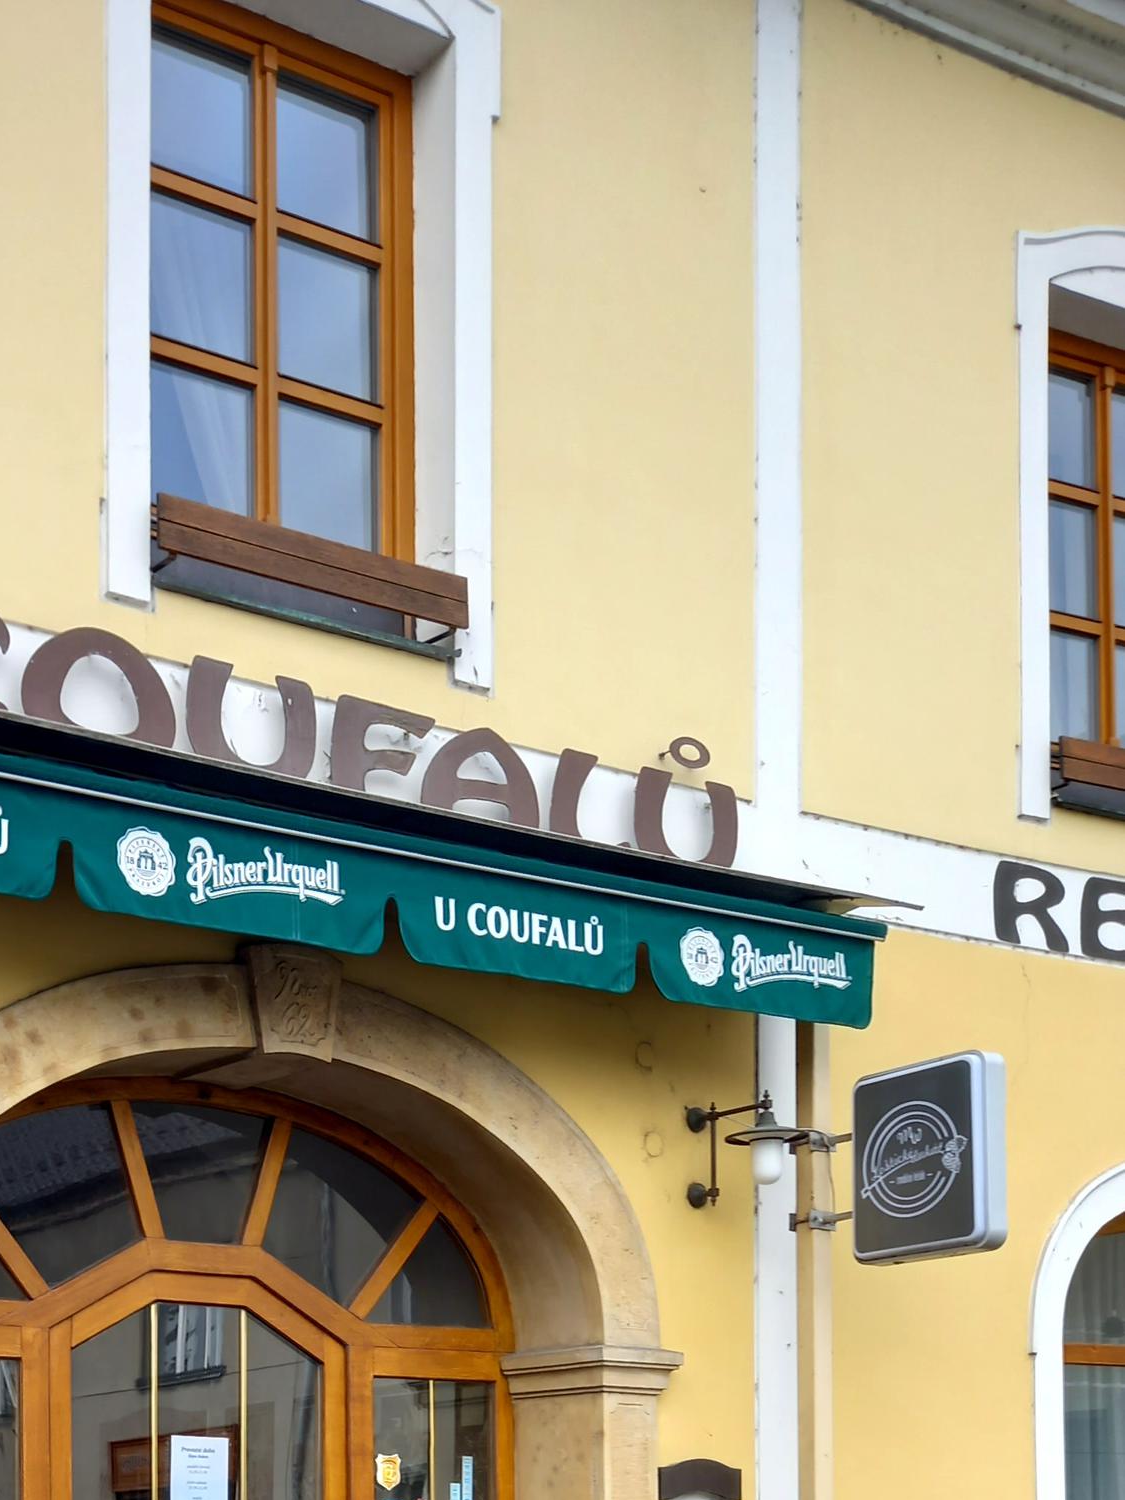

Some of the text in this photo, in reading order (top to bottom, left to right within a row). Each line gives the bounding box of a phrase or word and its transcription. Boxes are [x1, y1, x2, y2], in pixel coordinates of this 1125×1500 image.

[186, 837, 340, 905] Pilsner Urquell
[434, 896, 604, 956] U COUFALŮ
[731, 934, 792, 993] Pilsner
[788, 940, 846, 989] Urquell
